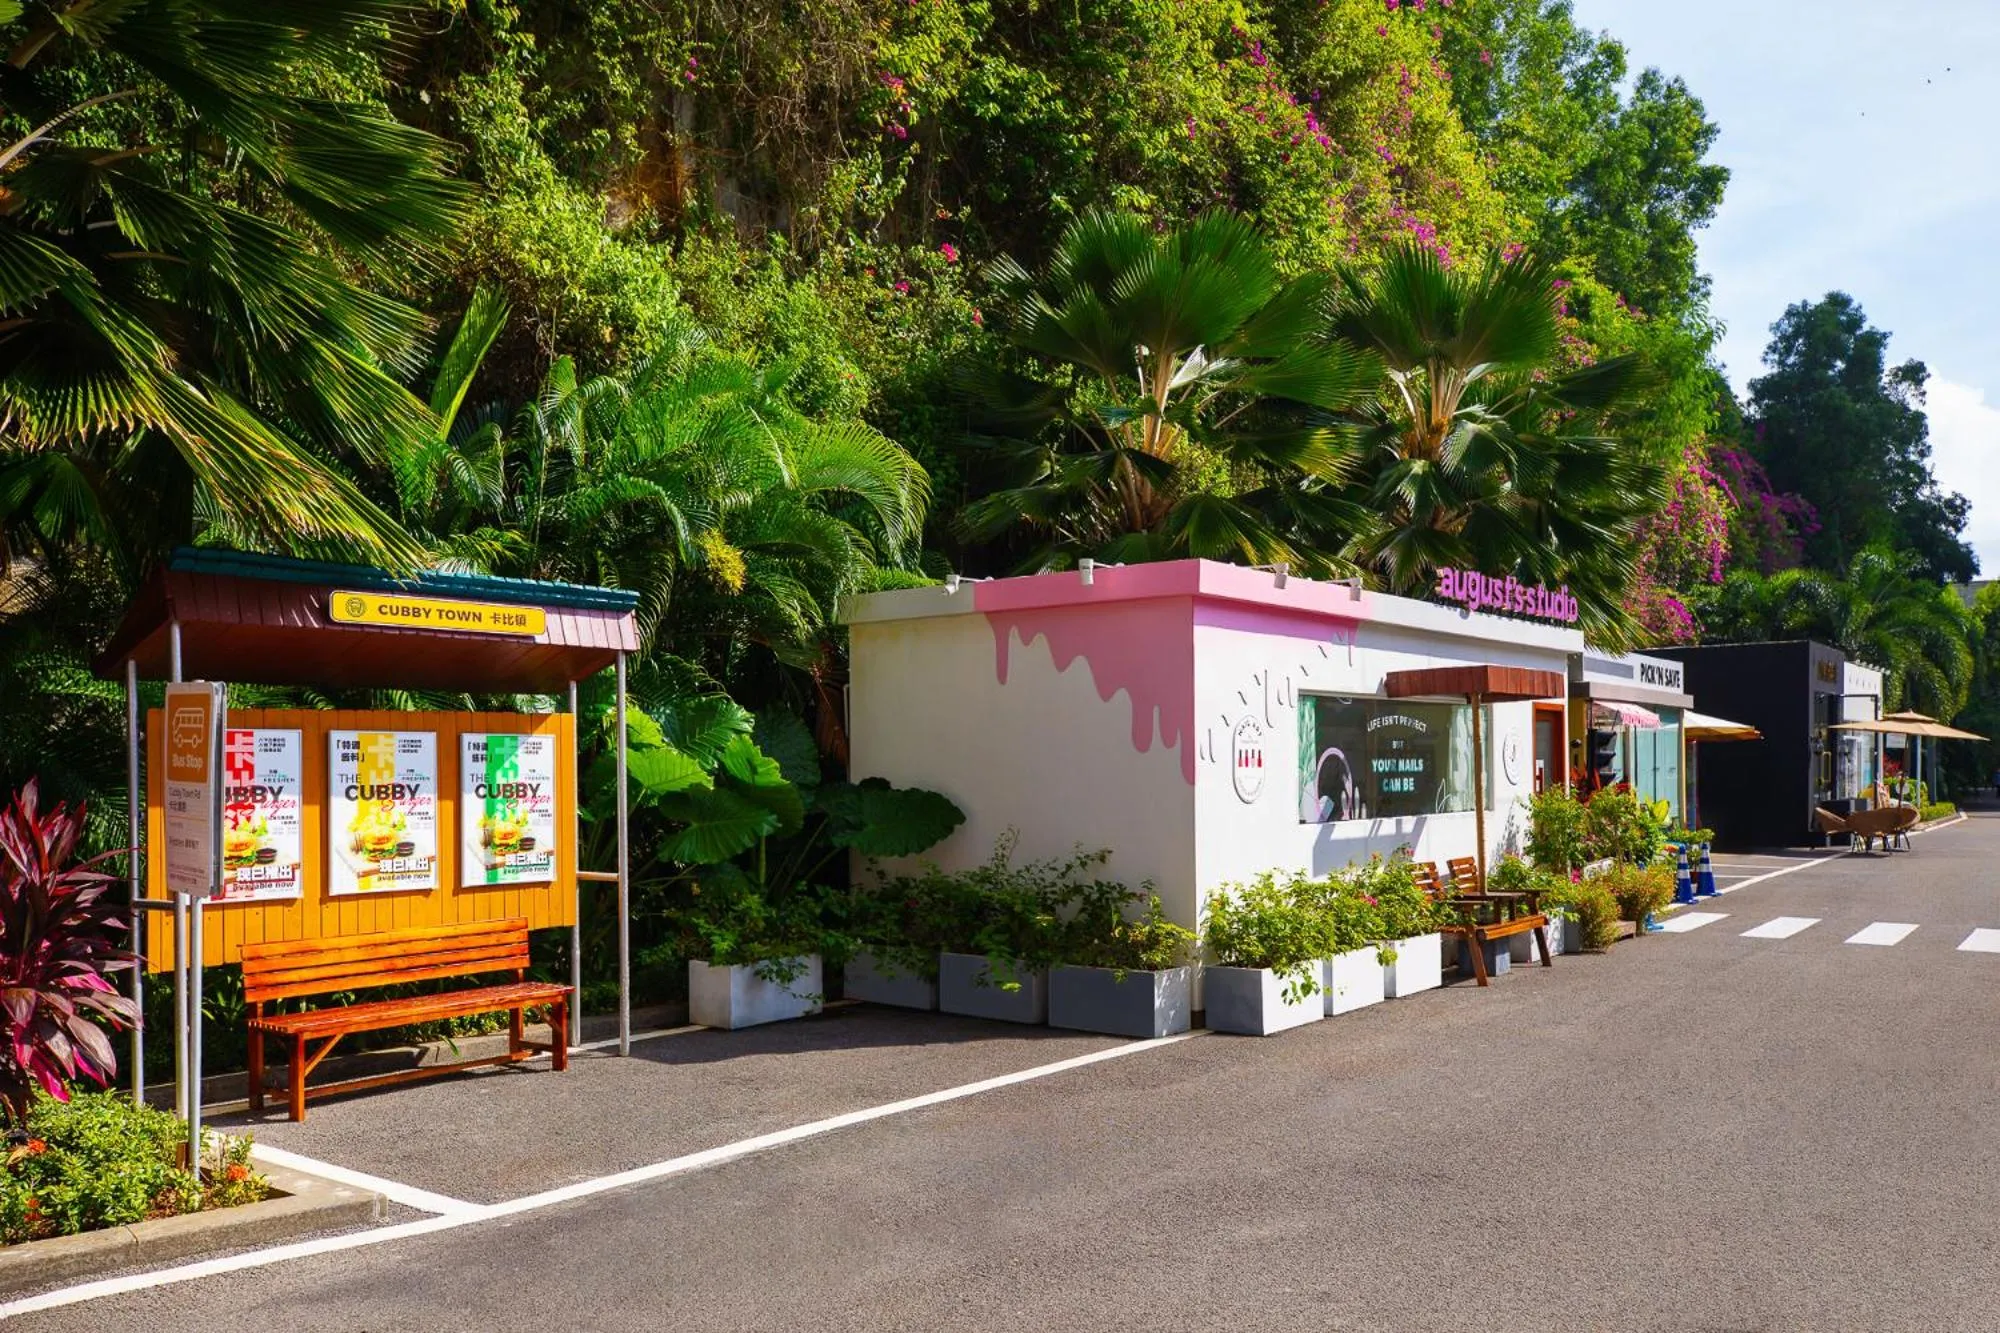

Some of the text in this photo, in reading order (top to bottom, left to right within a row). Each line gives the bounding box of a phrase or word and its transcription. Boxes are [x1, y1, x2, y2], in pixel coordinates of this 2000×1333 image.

[1440, 566, 1579, 623] august's studio
[378, 604, 433, 619] CUBBY
[436, 608, 482, 623] TOWN
[1640, 662, 1656, 685] PICK
[1664, 667, 1680, 689] SAVE
[1367, 717, 1382, 732] LIFE
[171, 753, 204, 772] Bus Stop
[1371, 757, 1424, 772] YOUR NAILS
[339, 774, 362, 784] THE
[470, 773, 490, 783] THE
[1382, 777, 1415, 792] CAN BE
[344, 784, 420, 802] CUBBY
[475, 783, 541, 799] CUBBY
[377, 874, 411, 882] available
[233, 882, 273, 892] available
